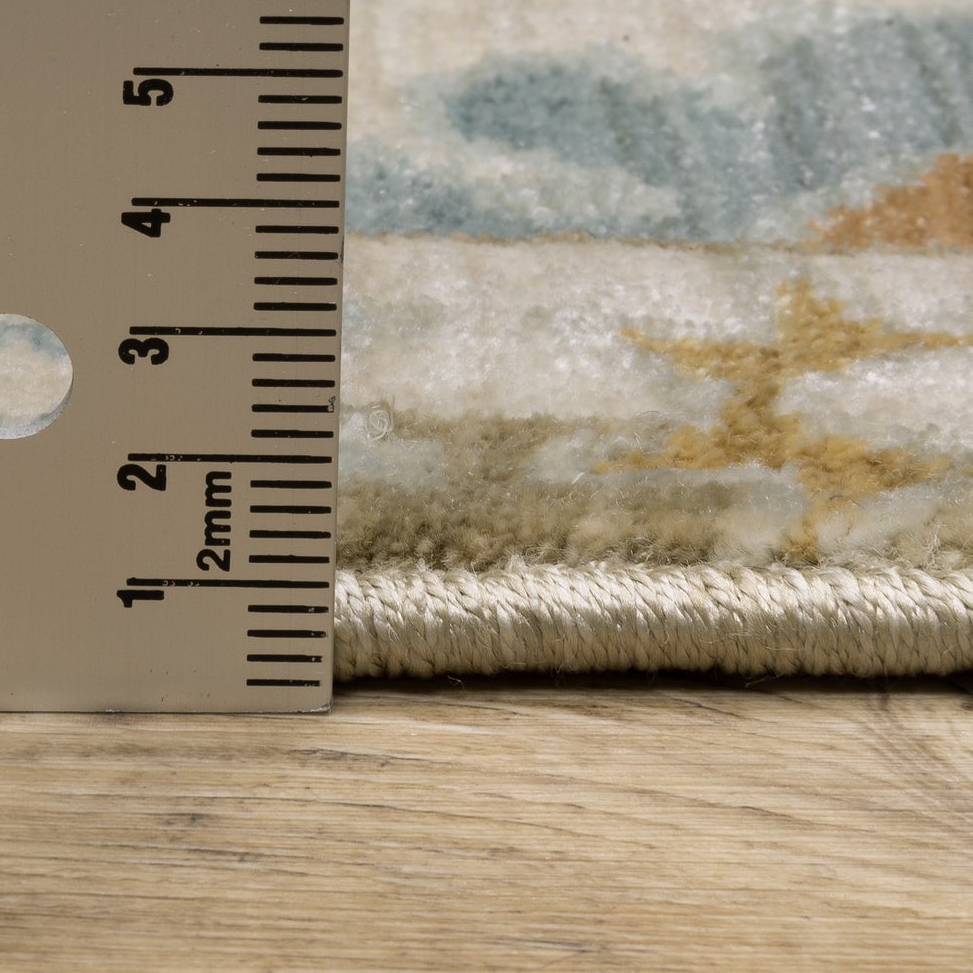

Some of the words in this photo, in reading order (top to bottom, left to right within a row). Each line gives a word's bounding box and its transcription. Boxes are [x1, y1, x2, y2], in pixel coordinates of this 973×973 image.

[122, 78, 174, 107] 5
[120, 207, 172, 238] 4
[117, 337, 170, 366] 3
[116, 463, 167, 492] 2
[195, 470, 233, 573] 2mm
[116, 589, 165, 609] 1
